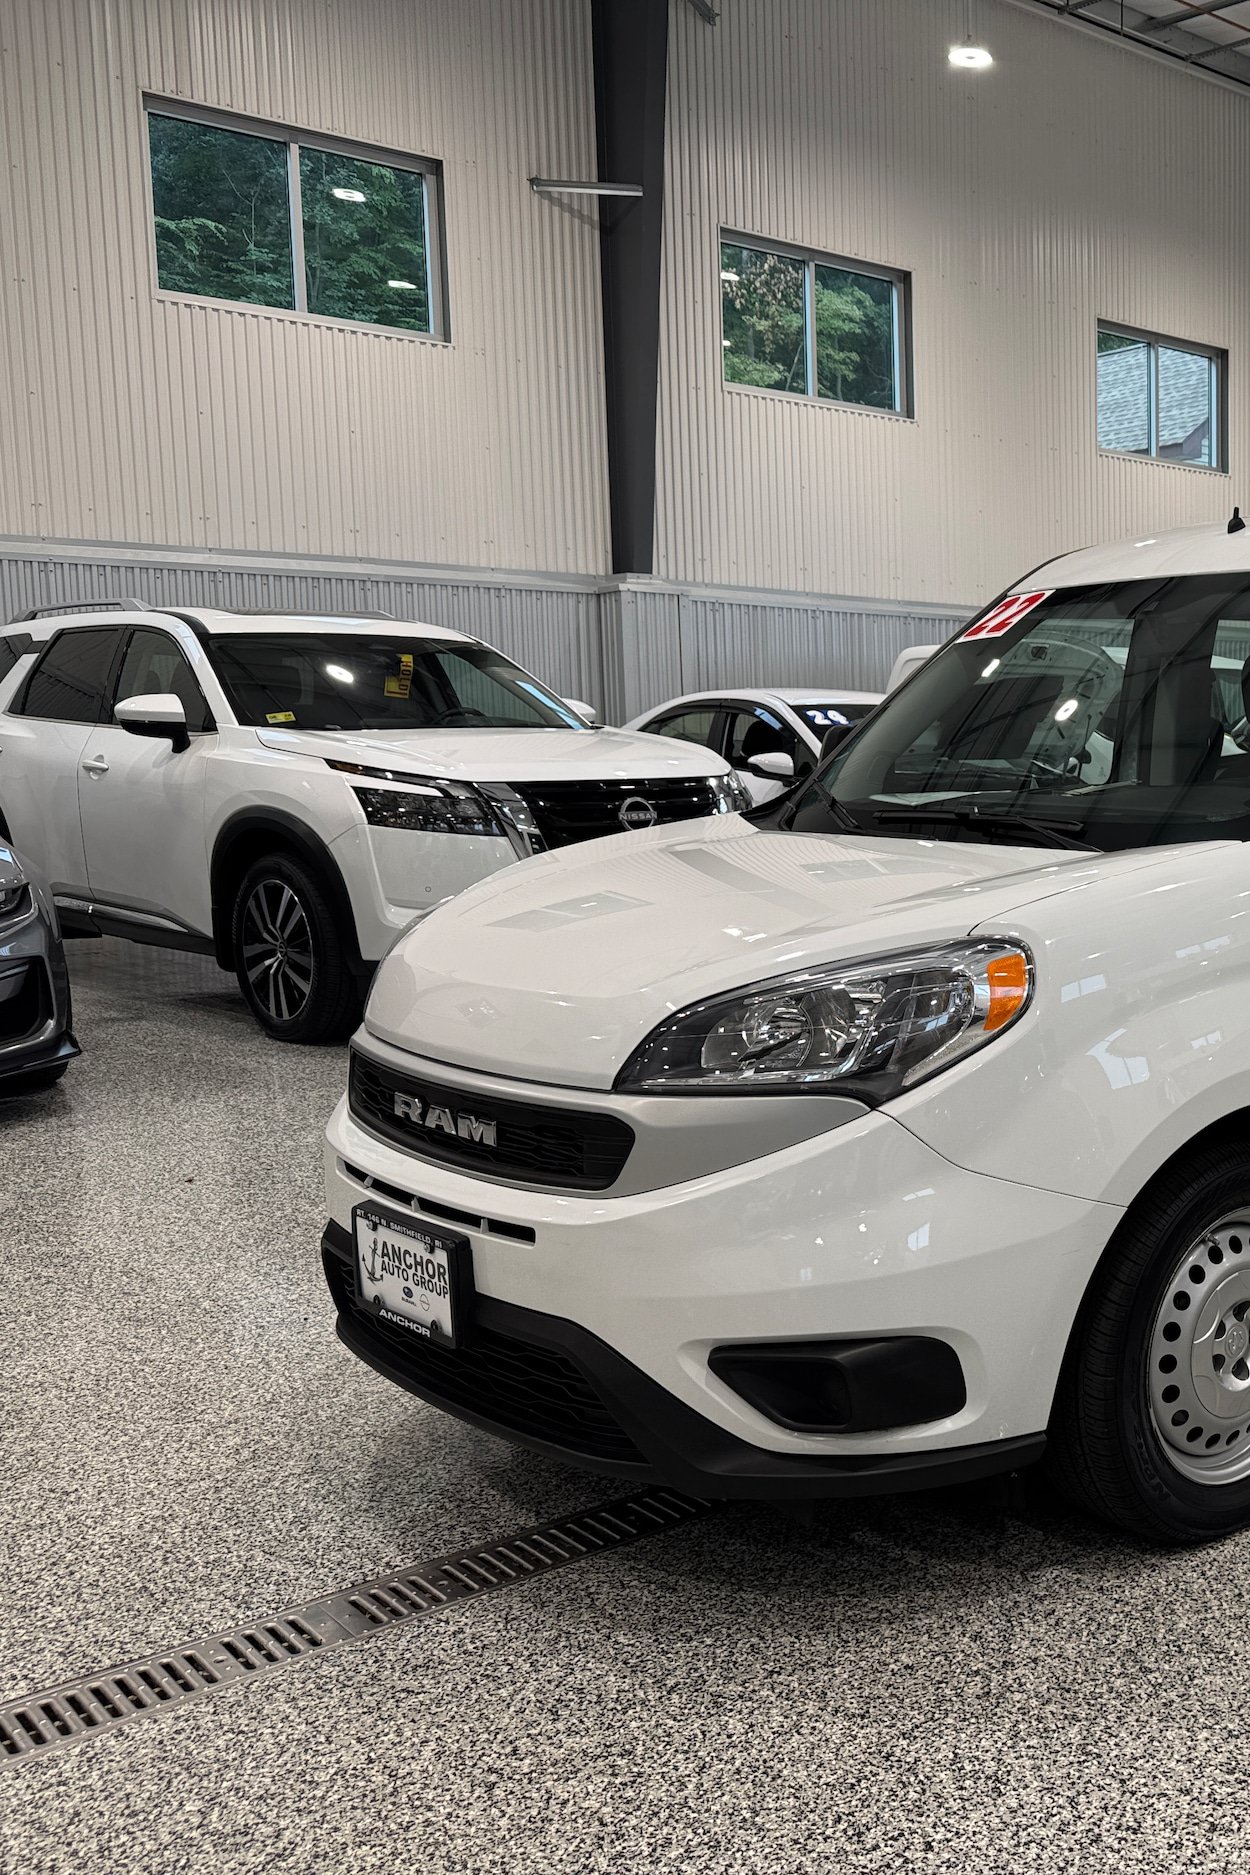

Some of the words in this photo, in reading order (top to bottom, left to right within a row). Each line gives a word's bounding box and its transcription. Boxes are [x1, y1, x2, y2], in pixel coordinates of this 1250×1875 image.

[963, 592, 1046, 638] 22
[398, 660, 412, 691] HOLD
[619, 812, 657, 820] NISSAN
[394, 1091, 497, 1147] RAM
[434, 1239, 443, 1249] RI
[380, 1259, 409, 1282] AUTO
[412, 1273, 449, 1299] GROUP
[381, 1241, 448, 1286] ANCHOR
[379, 1308, 431, 1338] ANCHOR
